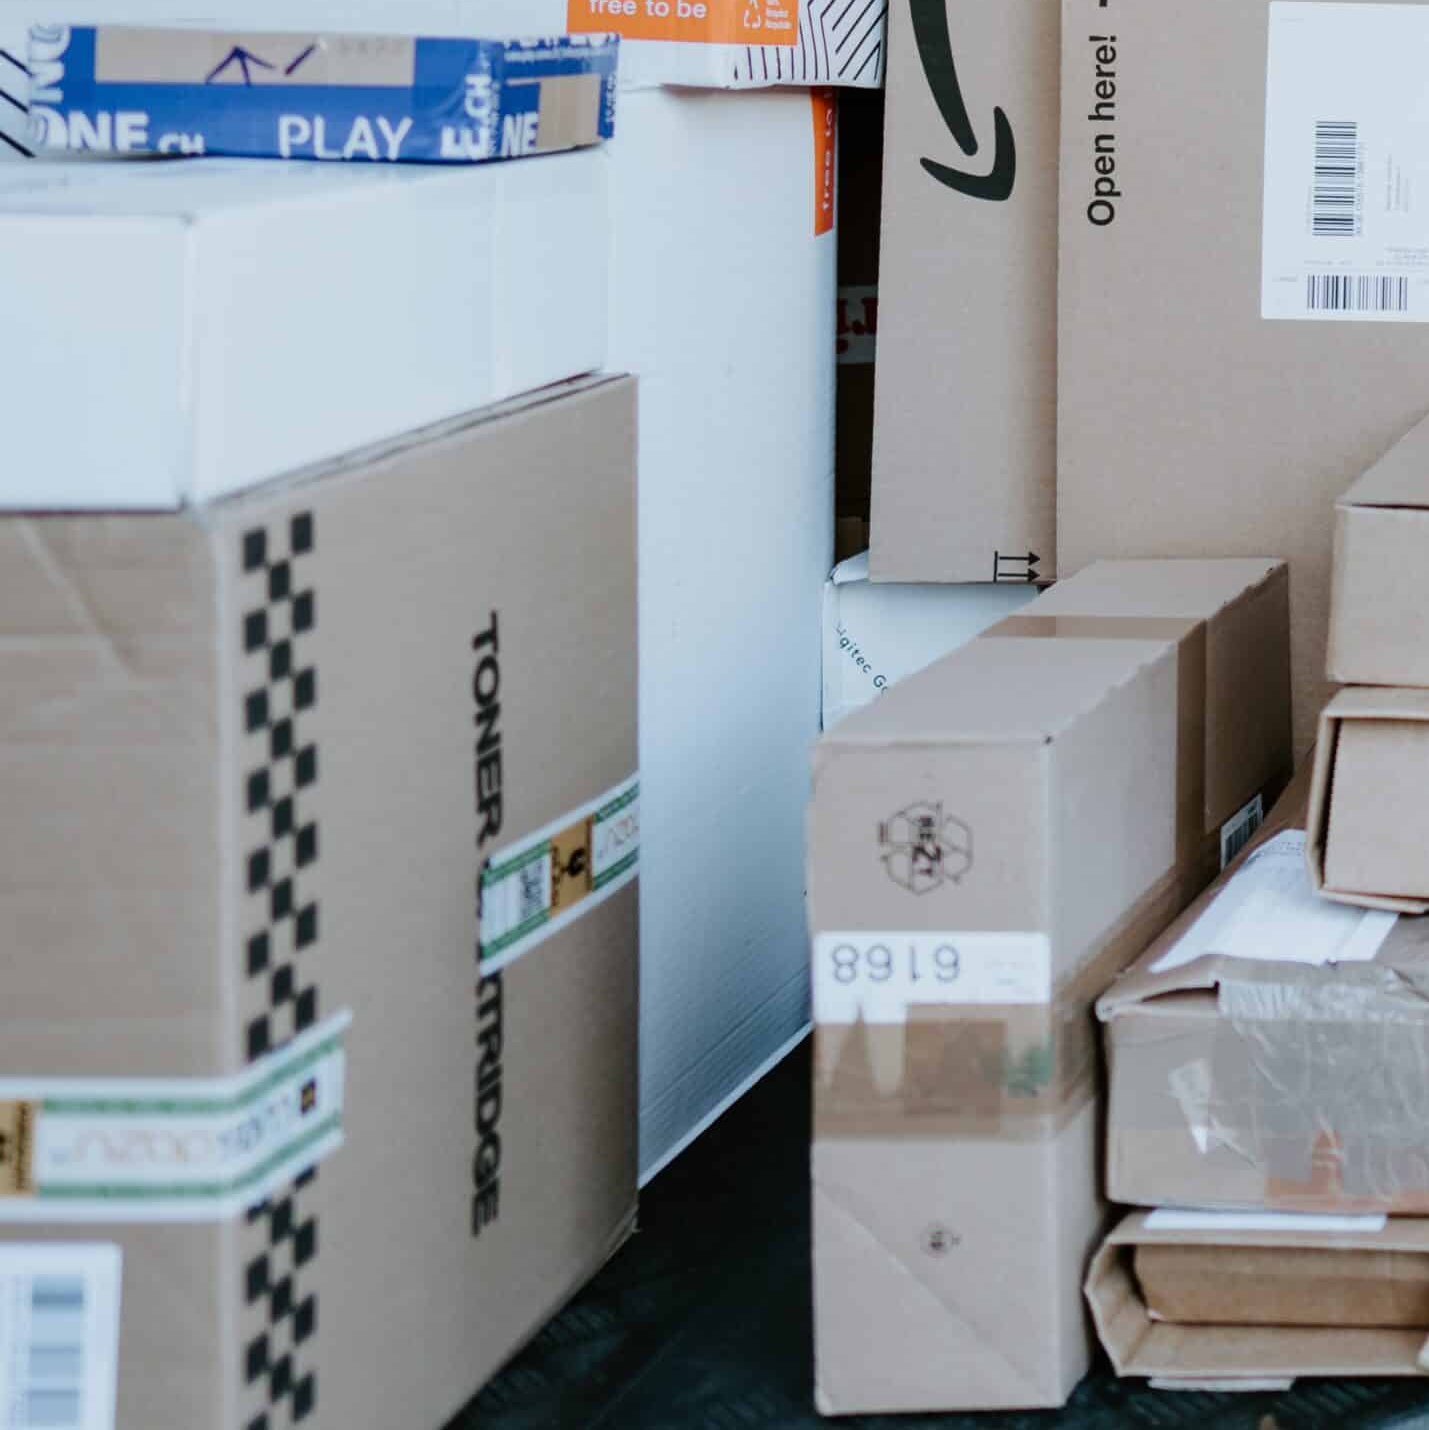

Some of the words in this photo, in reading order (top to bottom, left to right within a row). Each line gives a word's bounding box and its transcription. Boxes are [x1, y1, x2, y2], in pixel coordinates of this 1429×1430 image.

[1088, 33, 1117, 125] here!
[277, 114, 414, 161] PLAY
[1086, 133, 1122, 227] Open
[471, 609, 503, 847] TONER
[470, 860, 503, 1240] TRIDGE
